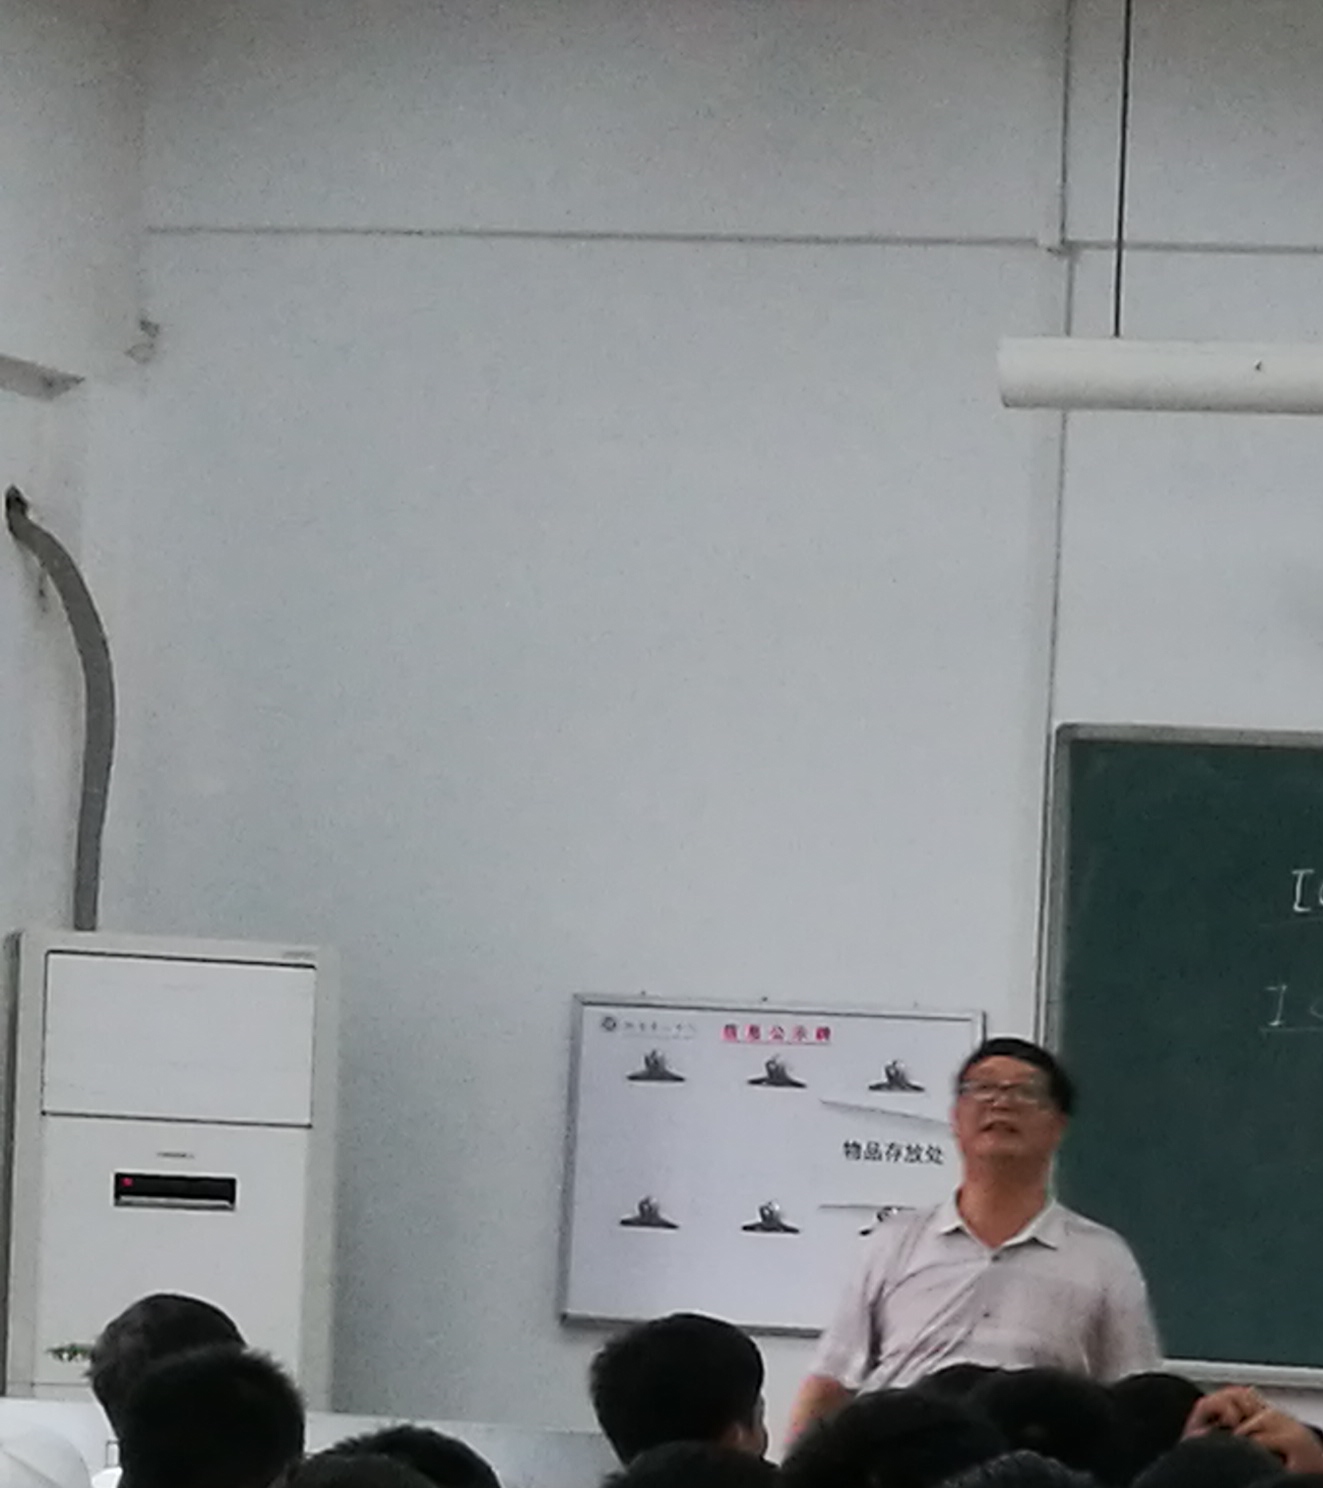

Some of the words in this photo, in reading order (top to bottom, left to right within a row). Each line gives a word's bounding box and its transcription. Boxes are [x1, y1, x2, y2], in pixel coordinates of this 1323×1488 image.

[842, 1139, 944, 1166] 物品存放处
